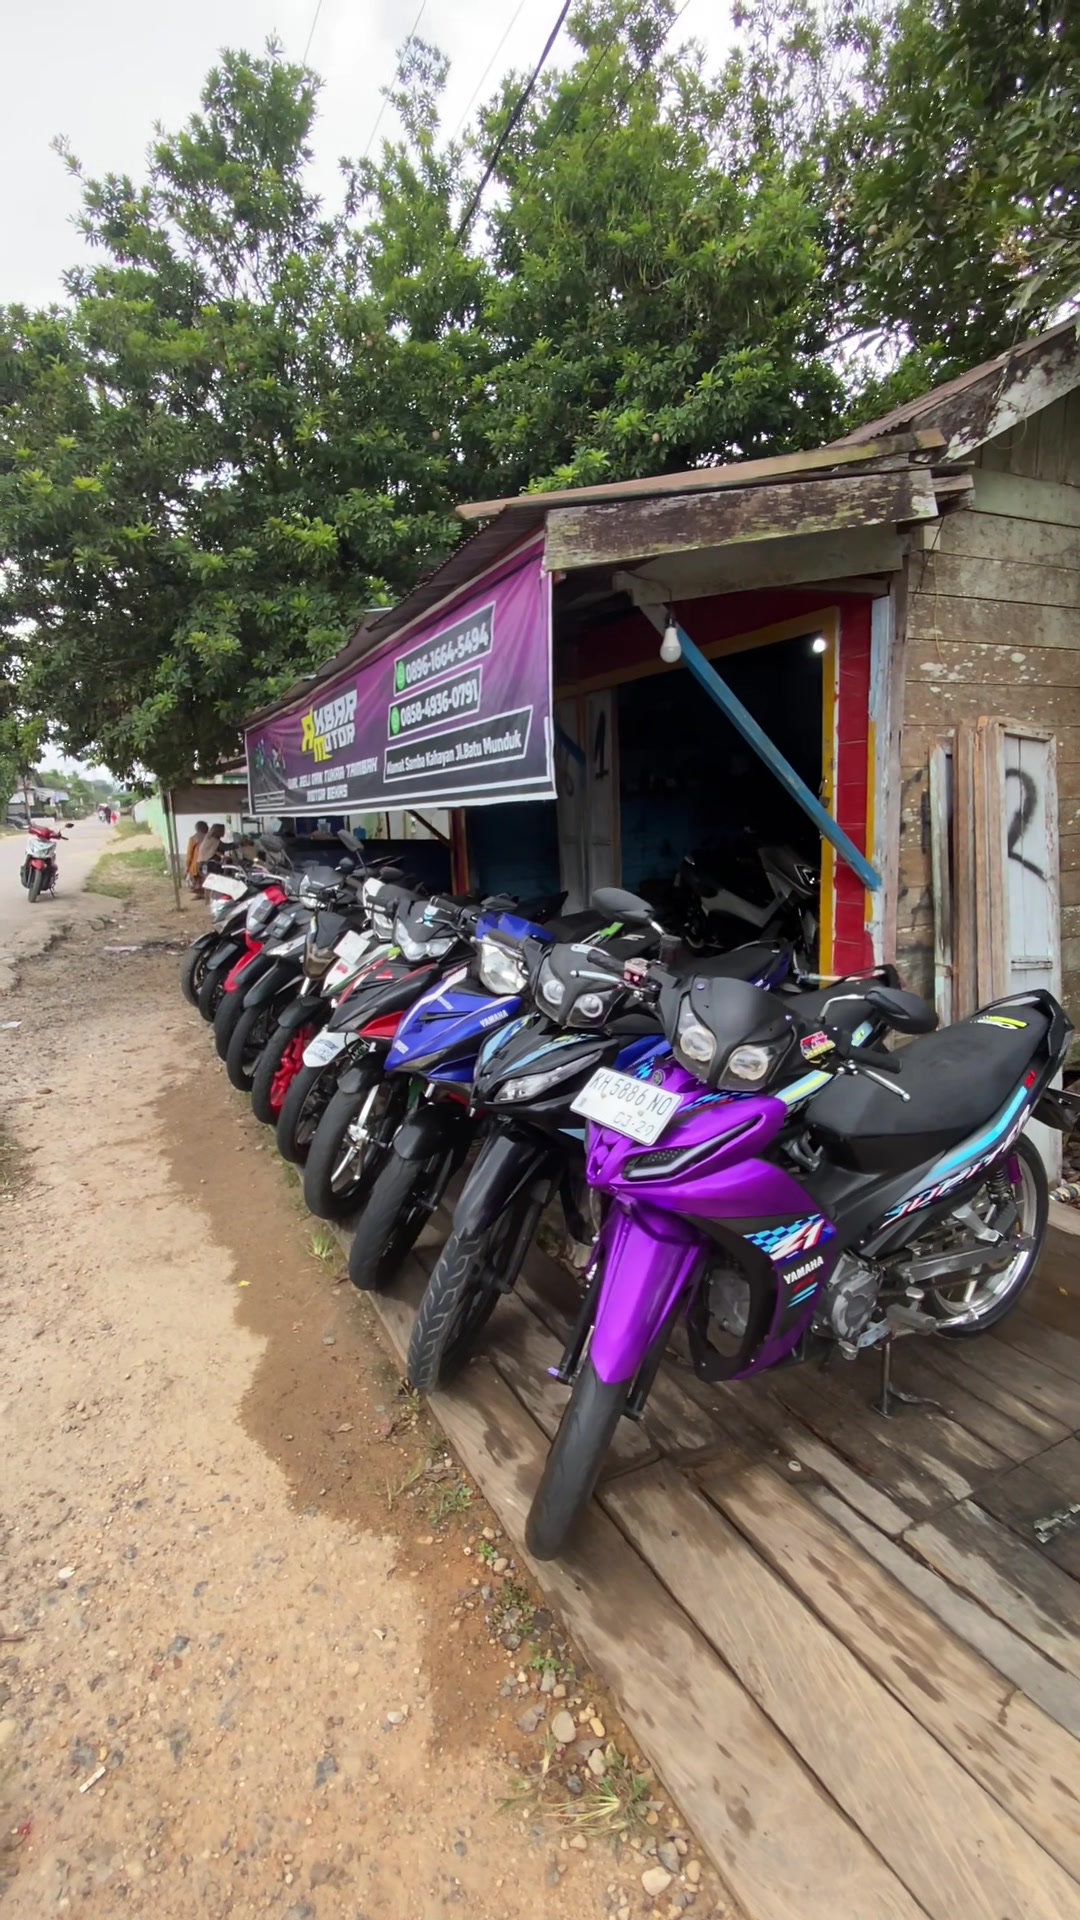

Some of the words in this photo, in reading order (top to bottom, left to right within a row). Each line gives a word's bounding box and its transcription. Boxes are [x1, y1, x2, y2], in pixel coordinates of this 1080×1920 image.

[405, 622, 489, 684] 0896-1664-5494
[301, 690, 357, 752] AKBAR
[400, 678, 478, 727] 0858-4936-0791
[482, 729, 522, 754] Munduk
[1005, 767, 1048, 882] 2
[479, 1009, 509, 1028] YAMAHA
[589, 1073, 614, 1089] KH
[609, 1079, 649, 1106] 5886
[646, 1092, 673, 1116] NO
[783, 1255, 824, 1285] YAMAHA
